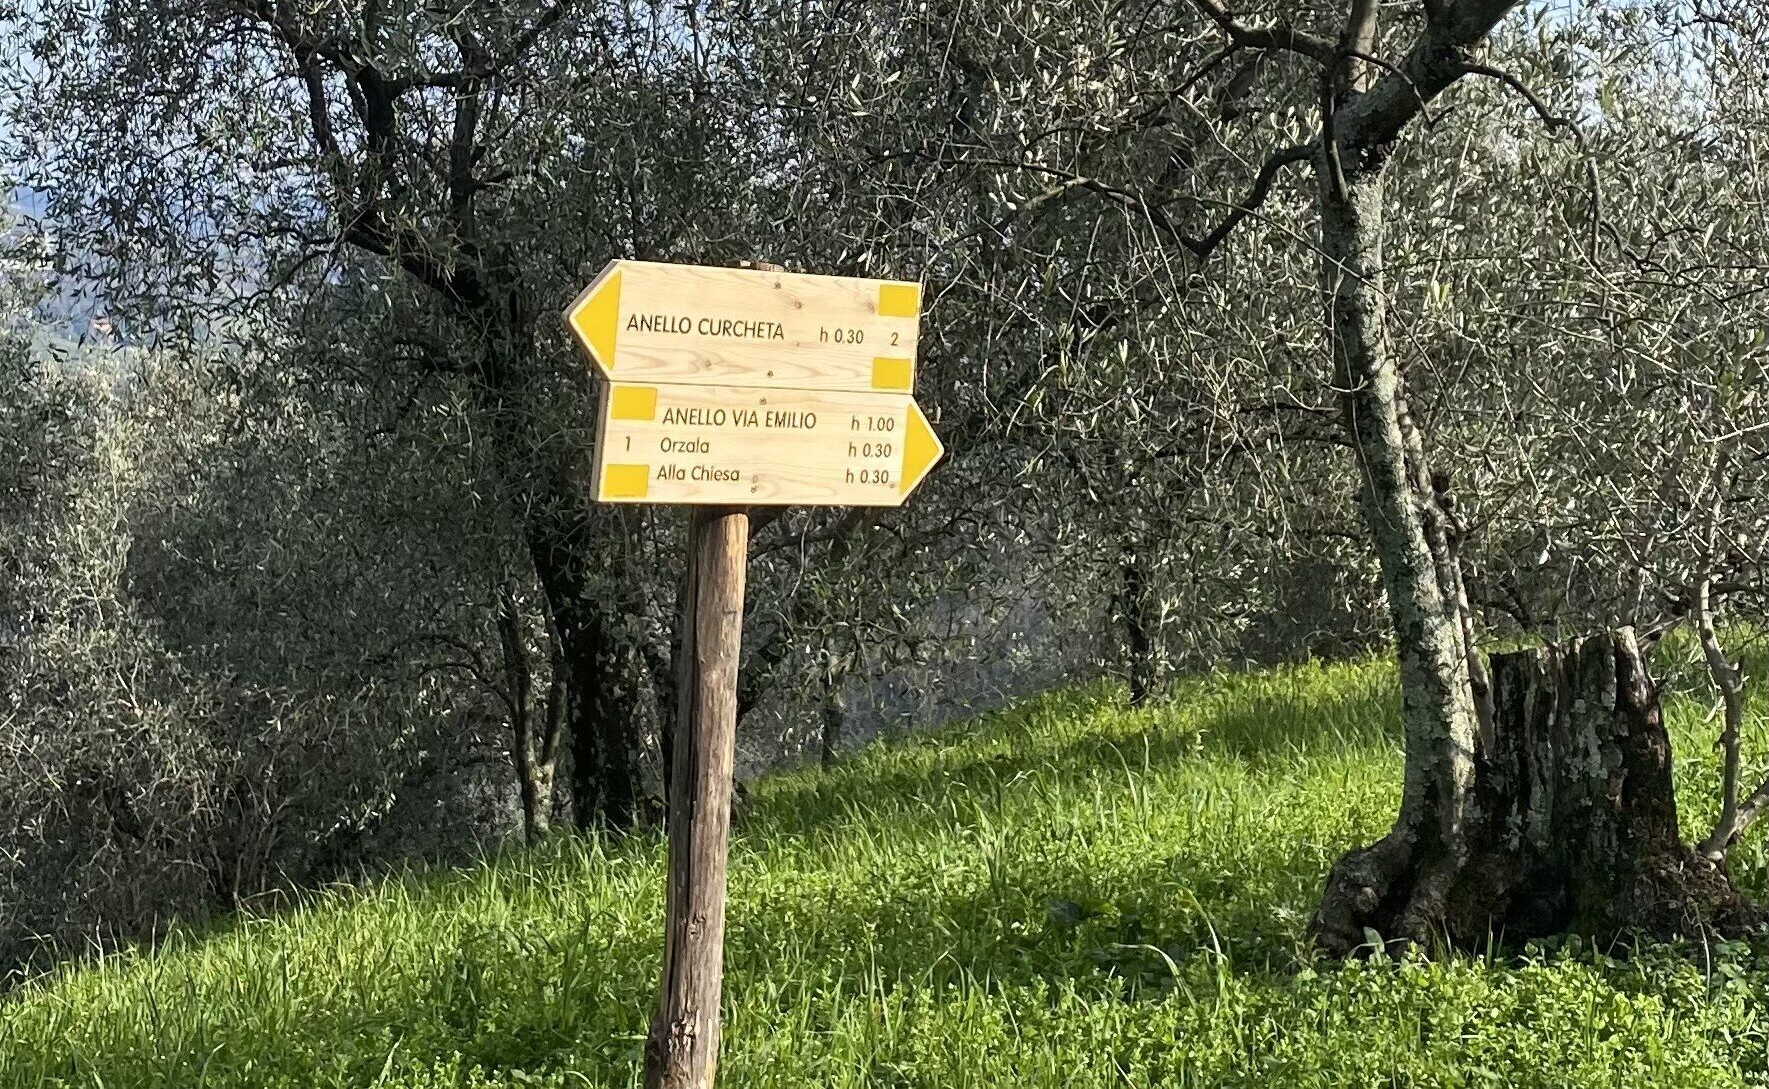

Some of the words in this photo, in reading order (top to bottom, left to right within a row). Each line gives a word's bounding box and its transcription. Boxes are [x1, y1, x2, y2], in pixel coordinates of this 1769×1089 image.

[626, 313, 692, 334] ANELLO
[698, 317, 785, 341] CURCHETA
[819, 326, 829, 343] h
[834, 328, 864, 345] 0.30
[890, 331, 899, 347] 2
[662, 407, 726, 427] ANELLO
[732, 409, 759, 428] VIA
[765, 410, 817, 430] EMILIO
[850, 415, 860, 431] h
[868, 416, 895, 432] 1.00
[625, 436, 631, 452] 1
[660, 436, 710, 454] Orzala
[848, 442, 857, 457] h
[862, 442, 892, 458] 0.30
[656, 464, 686, 481] Alla
[691, 465, 740, 482] Chiesa
[845, 468, 854, 484] h
[859, 469, 889, 485] 0.30
